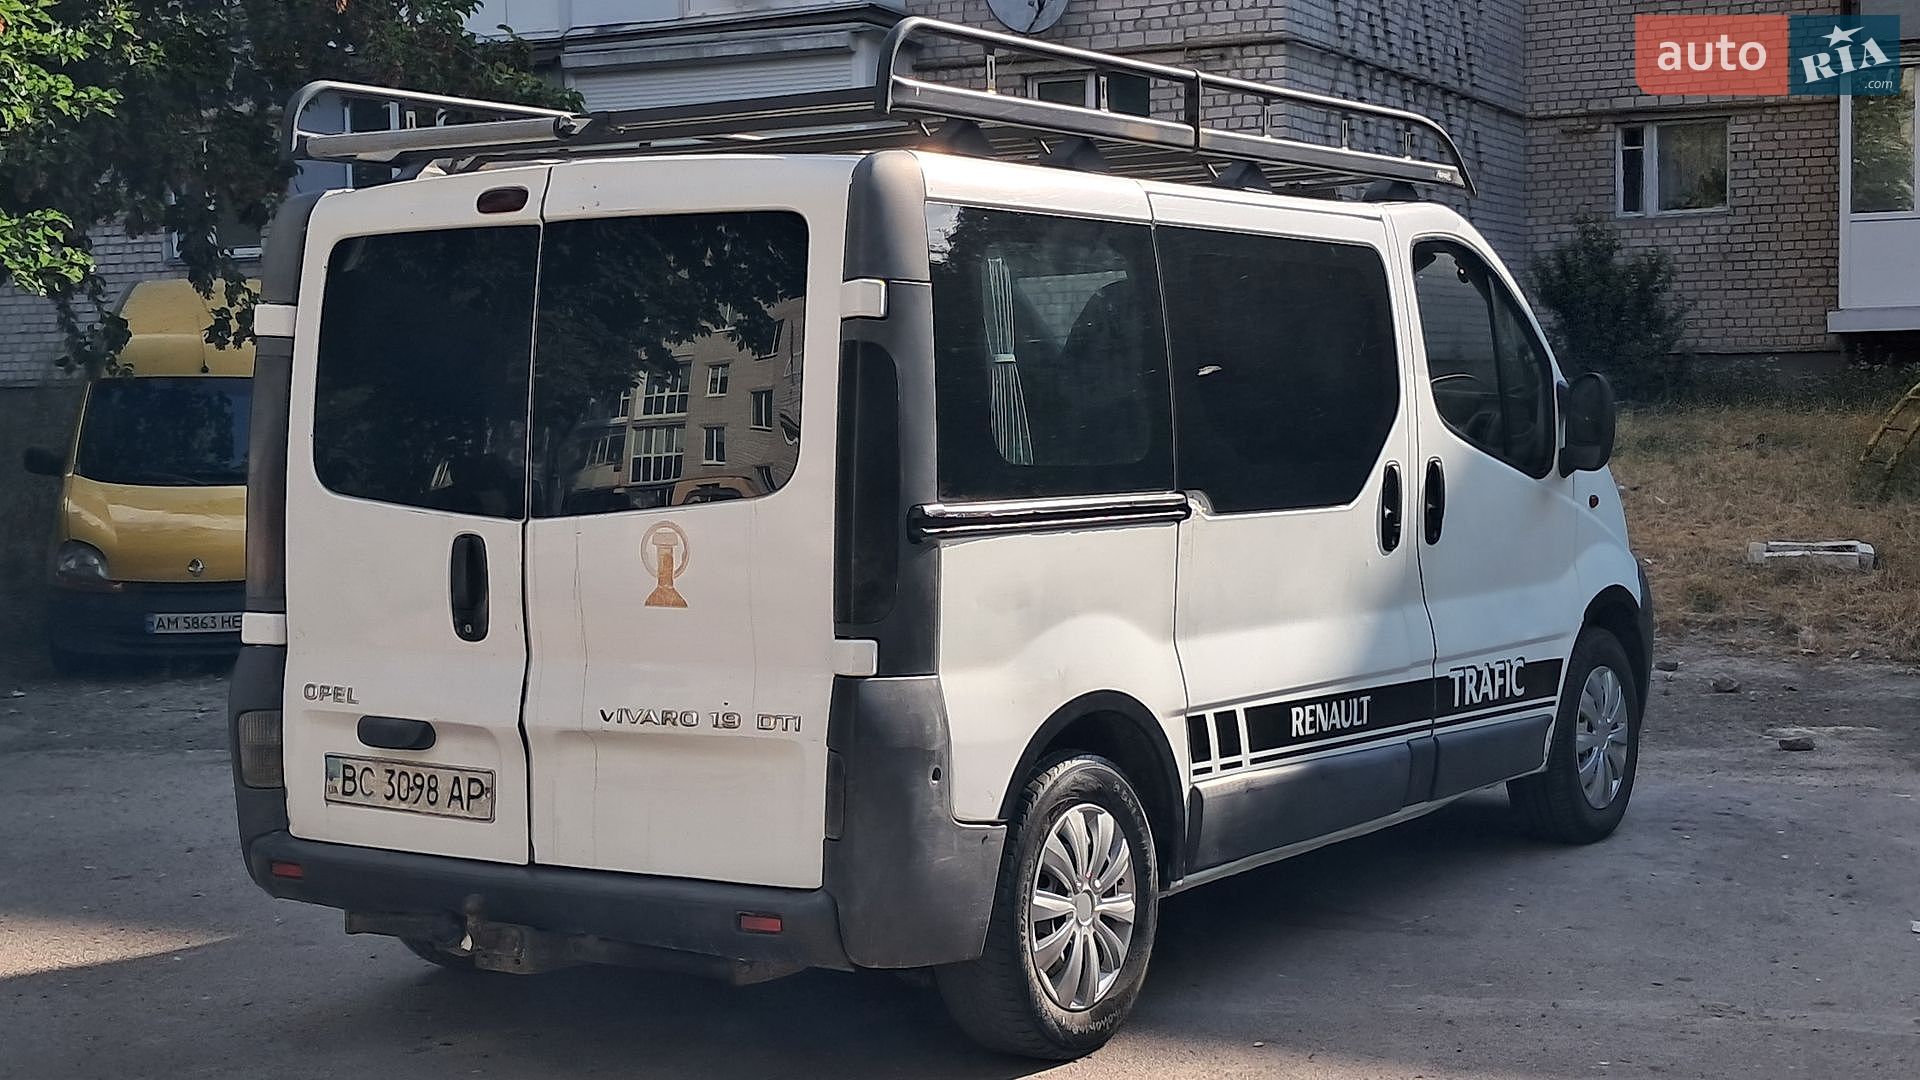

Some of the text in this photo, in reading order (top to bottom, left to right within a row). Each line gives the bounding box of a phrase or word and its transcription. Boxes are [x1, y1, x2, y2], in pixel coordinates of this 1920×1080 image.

[156, 616, 179, 630] AM
[183, 615, 217, 630] 5863
[303, 683, 360, 705] OPEL
[1450, 657, 1527, 708] TRAFIC
[599, 708, 700, 727] VIVARO
[756, 713, 802, 732] DTI
[1291, 696, 1371, 738] RENAULT
[341, 763, 486, 811] BC 3098 AP
